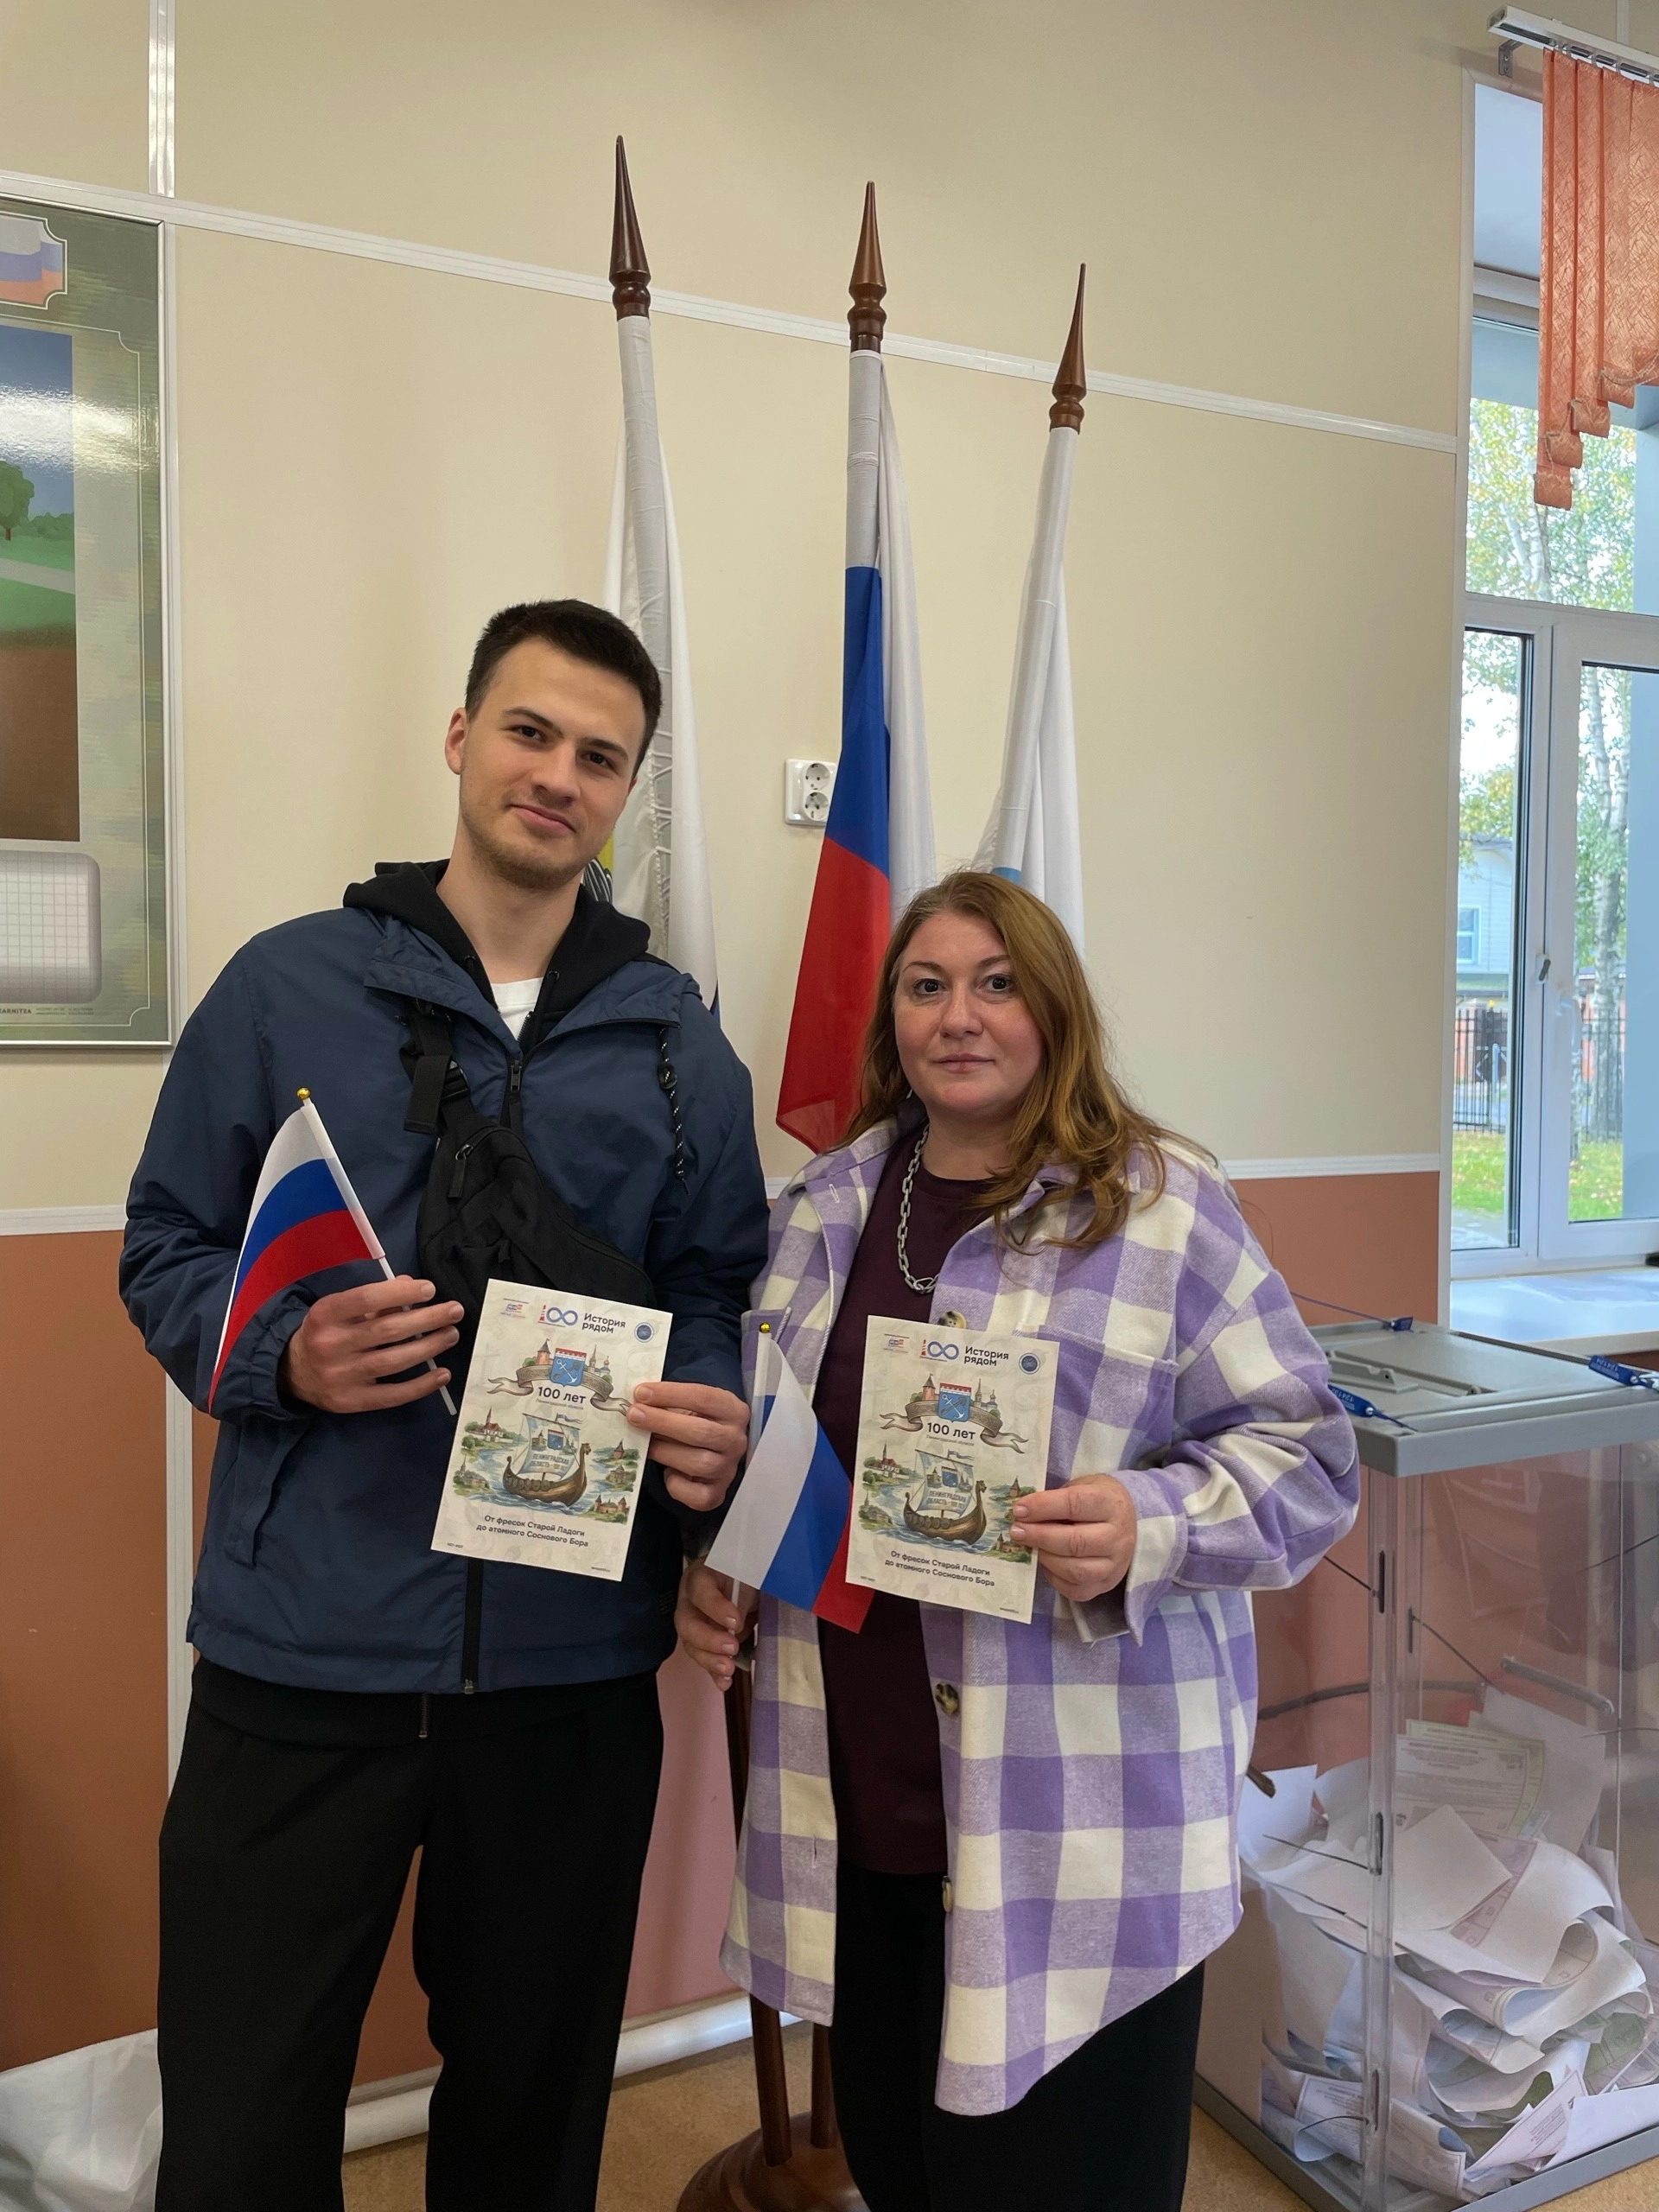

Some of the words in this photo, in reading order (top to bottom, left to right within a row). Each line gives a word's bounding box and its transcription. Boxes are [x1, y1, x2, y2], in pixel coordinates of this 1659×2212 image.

[582, 1322, 614, 1334] рядом
[583, 1313, 626, 1329] История
[963, 1356, 997, 1366] рядом
[964, 1346, 1009, 1360] История
[537, 1386, 561, 1399] 100
[563, 1393, 587, 1404] лет
[927, 1422, 950, 1435] 100
[953, 1429, 976, 1440] лет
[496, 1517, 525, 1528] фресок
[527, 1521, 556, 1532] Старой
[556, 1526, 585, 1536] Ладоги
[488, 1526, 524, 1536] атомного
[526, 1530, 568, 1543] Соснового
[569, 1537, 588, 1548] Бора
[895, 1562, 931, 1574] атомного
[931, 1568, 974, 1582] Соснового
[976, 1576, 995, 1586] Бора
[901, 1554, 930, 1565] фресок
[931, 1559, 960, 1570] Старой
[962, 1565, 990, 1576] Ладоги
